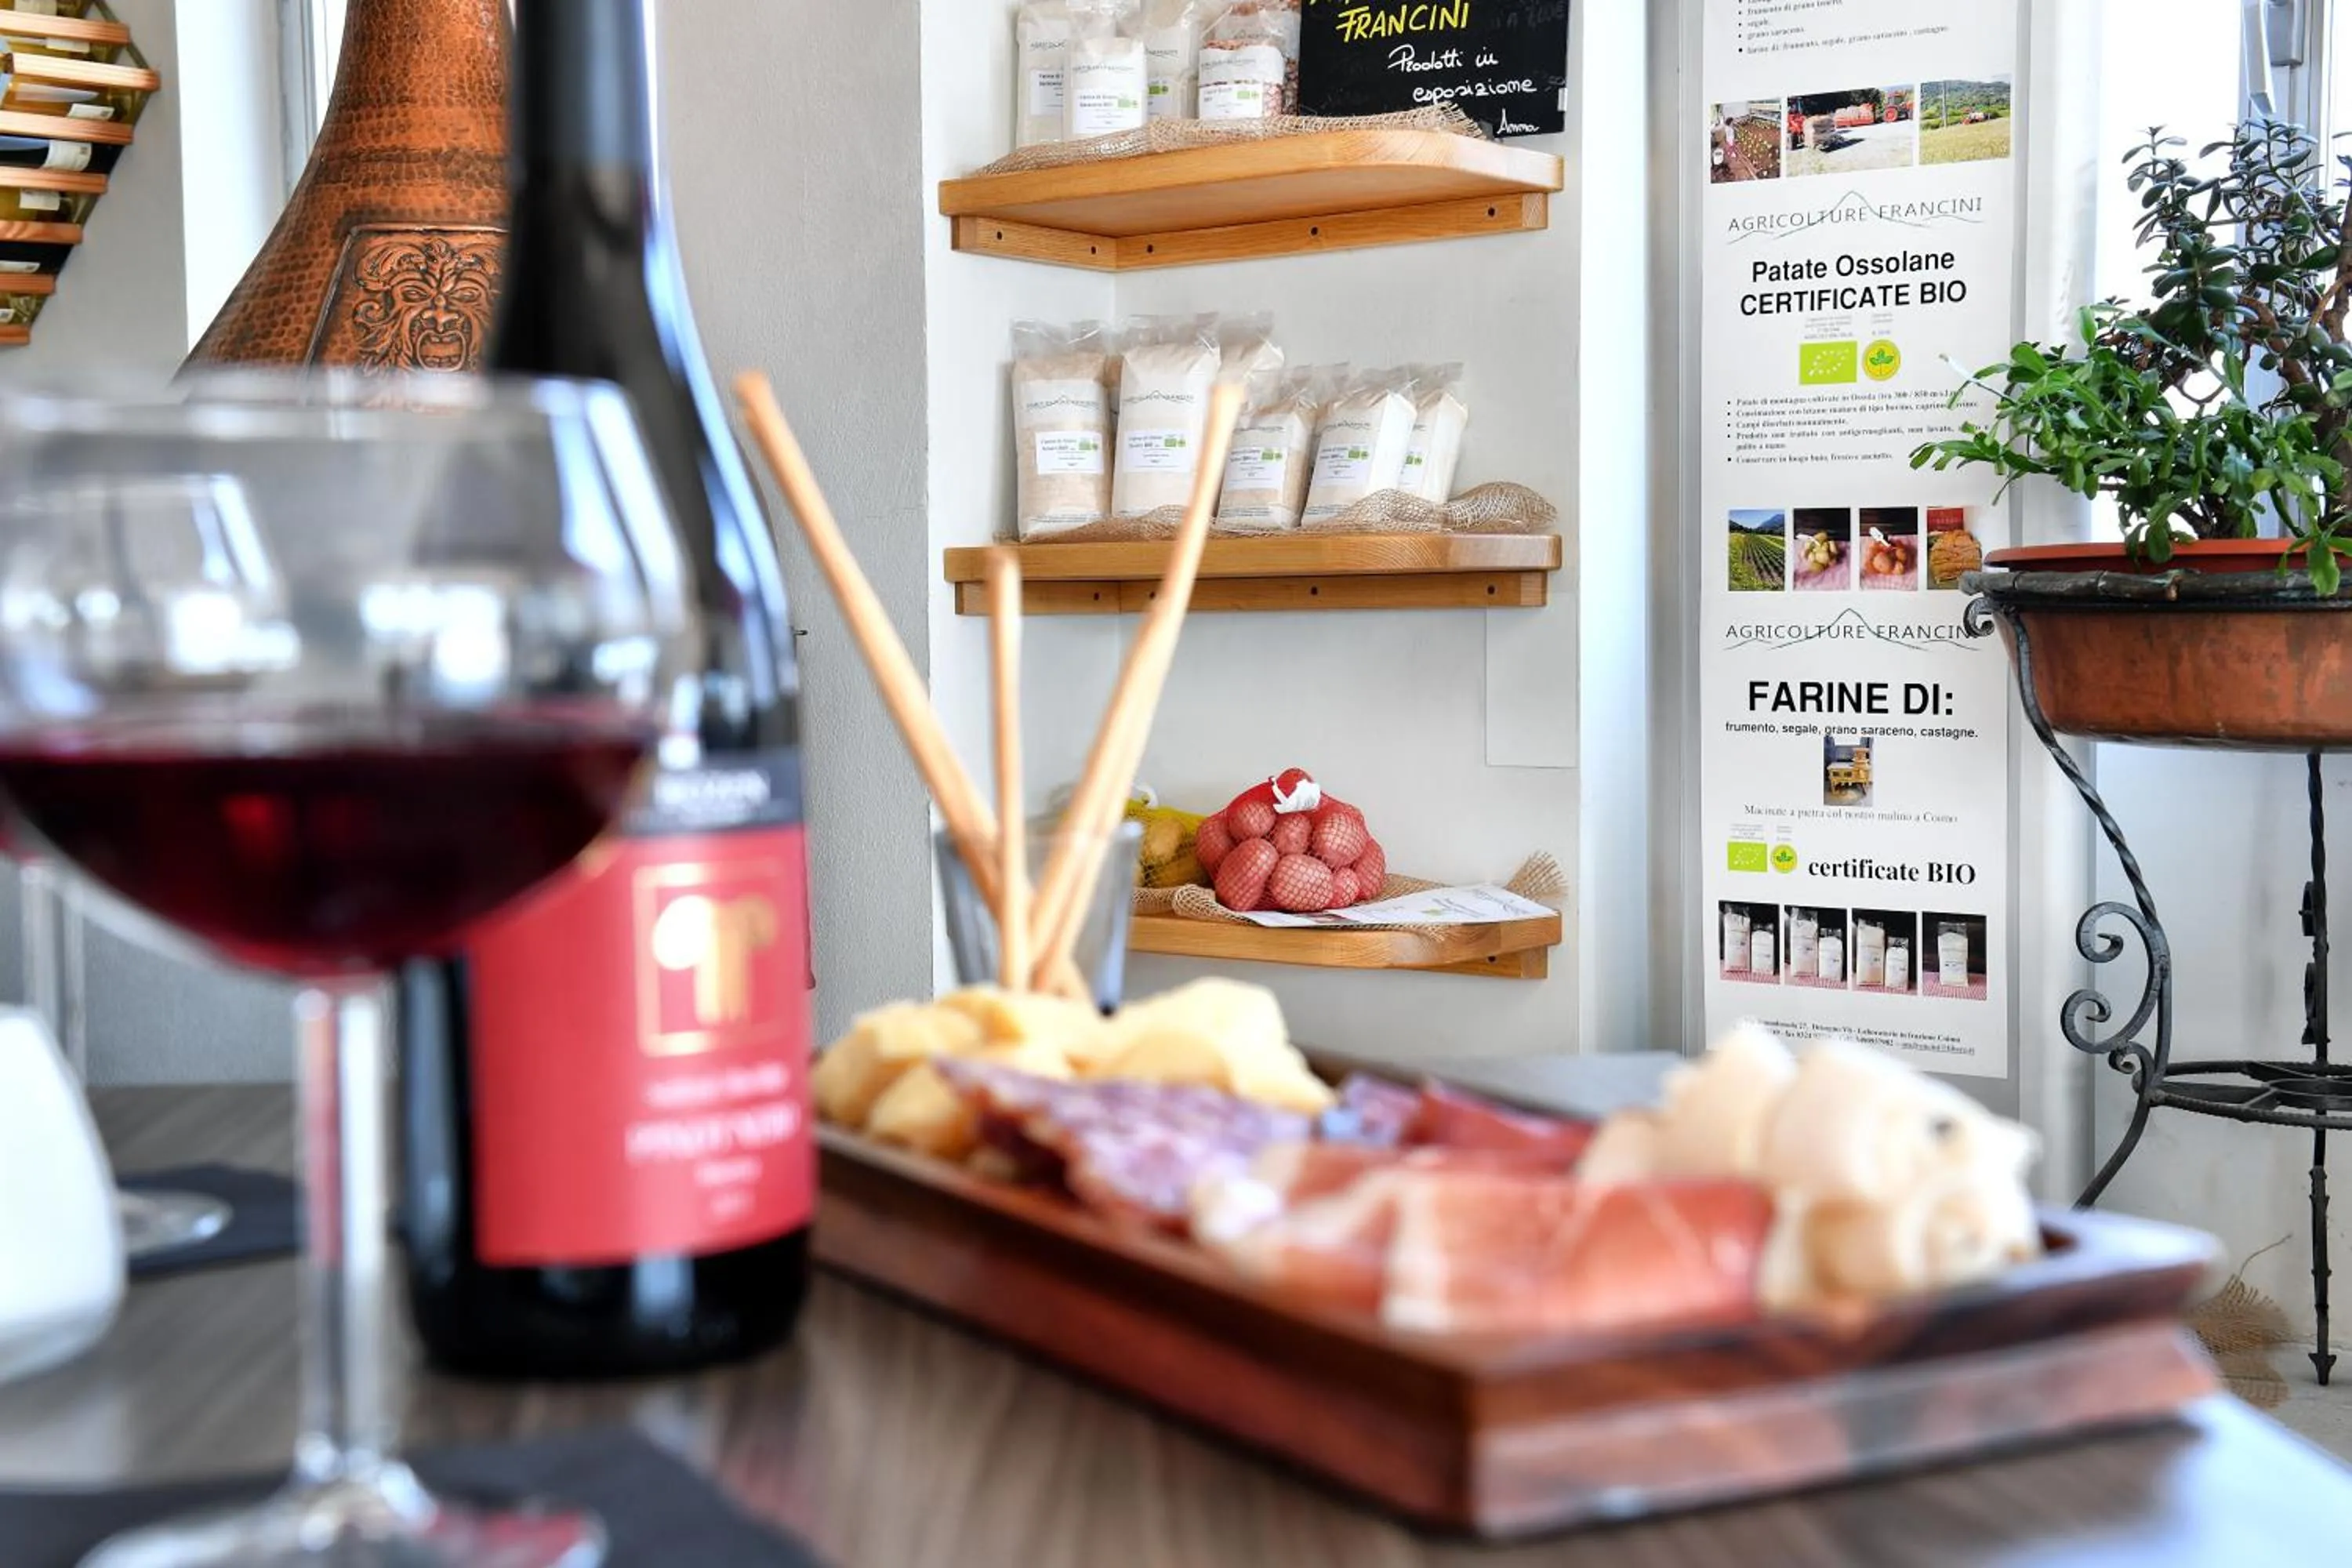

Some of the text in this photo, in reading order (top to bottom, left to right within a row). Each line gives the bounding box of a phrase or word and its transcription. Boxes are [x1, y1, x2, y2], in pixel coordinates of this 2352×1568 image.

[1336, 2, 1470, 42] FRANCINI
[1388, 44, 1499, 72] Prodotti in
[1413, 78, 1537, 105] esposizione
[1728, 196, 1983, 232] AGRICOLTURE FRANCINI
[1752, 251, 1955, 283] Patate Ossolane
[1740, 280, 1967, 316] CERTIFICATE BIO
[1726, 625, 1973, 640] AGRICOLTURE FRANCIN
[1749, 681, 1953, 715] FARINE DI:
[1726, 721, 1779, 735] frumento,
[1782, 724, 1821, 736] segale,
[1860, 725, 1917, 738] saraceno,
[1920, 727, 1978, 740] castagne.
[1809, 858, 1976, 885] certificate BIO
